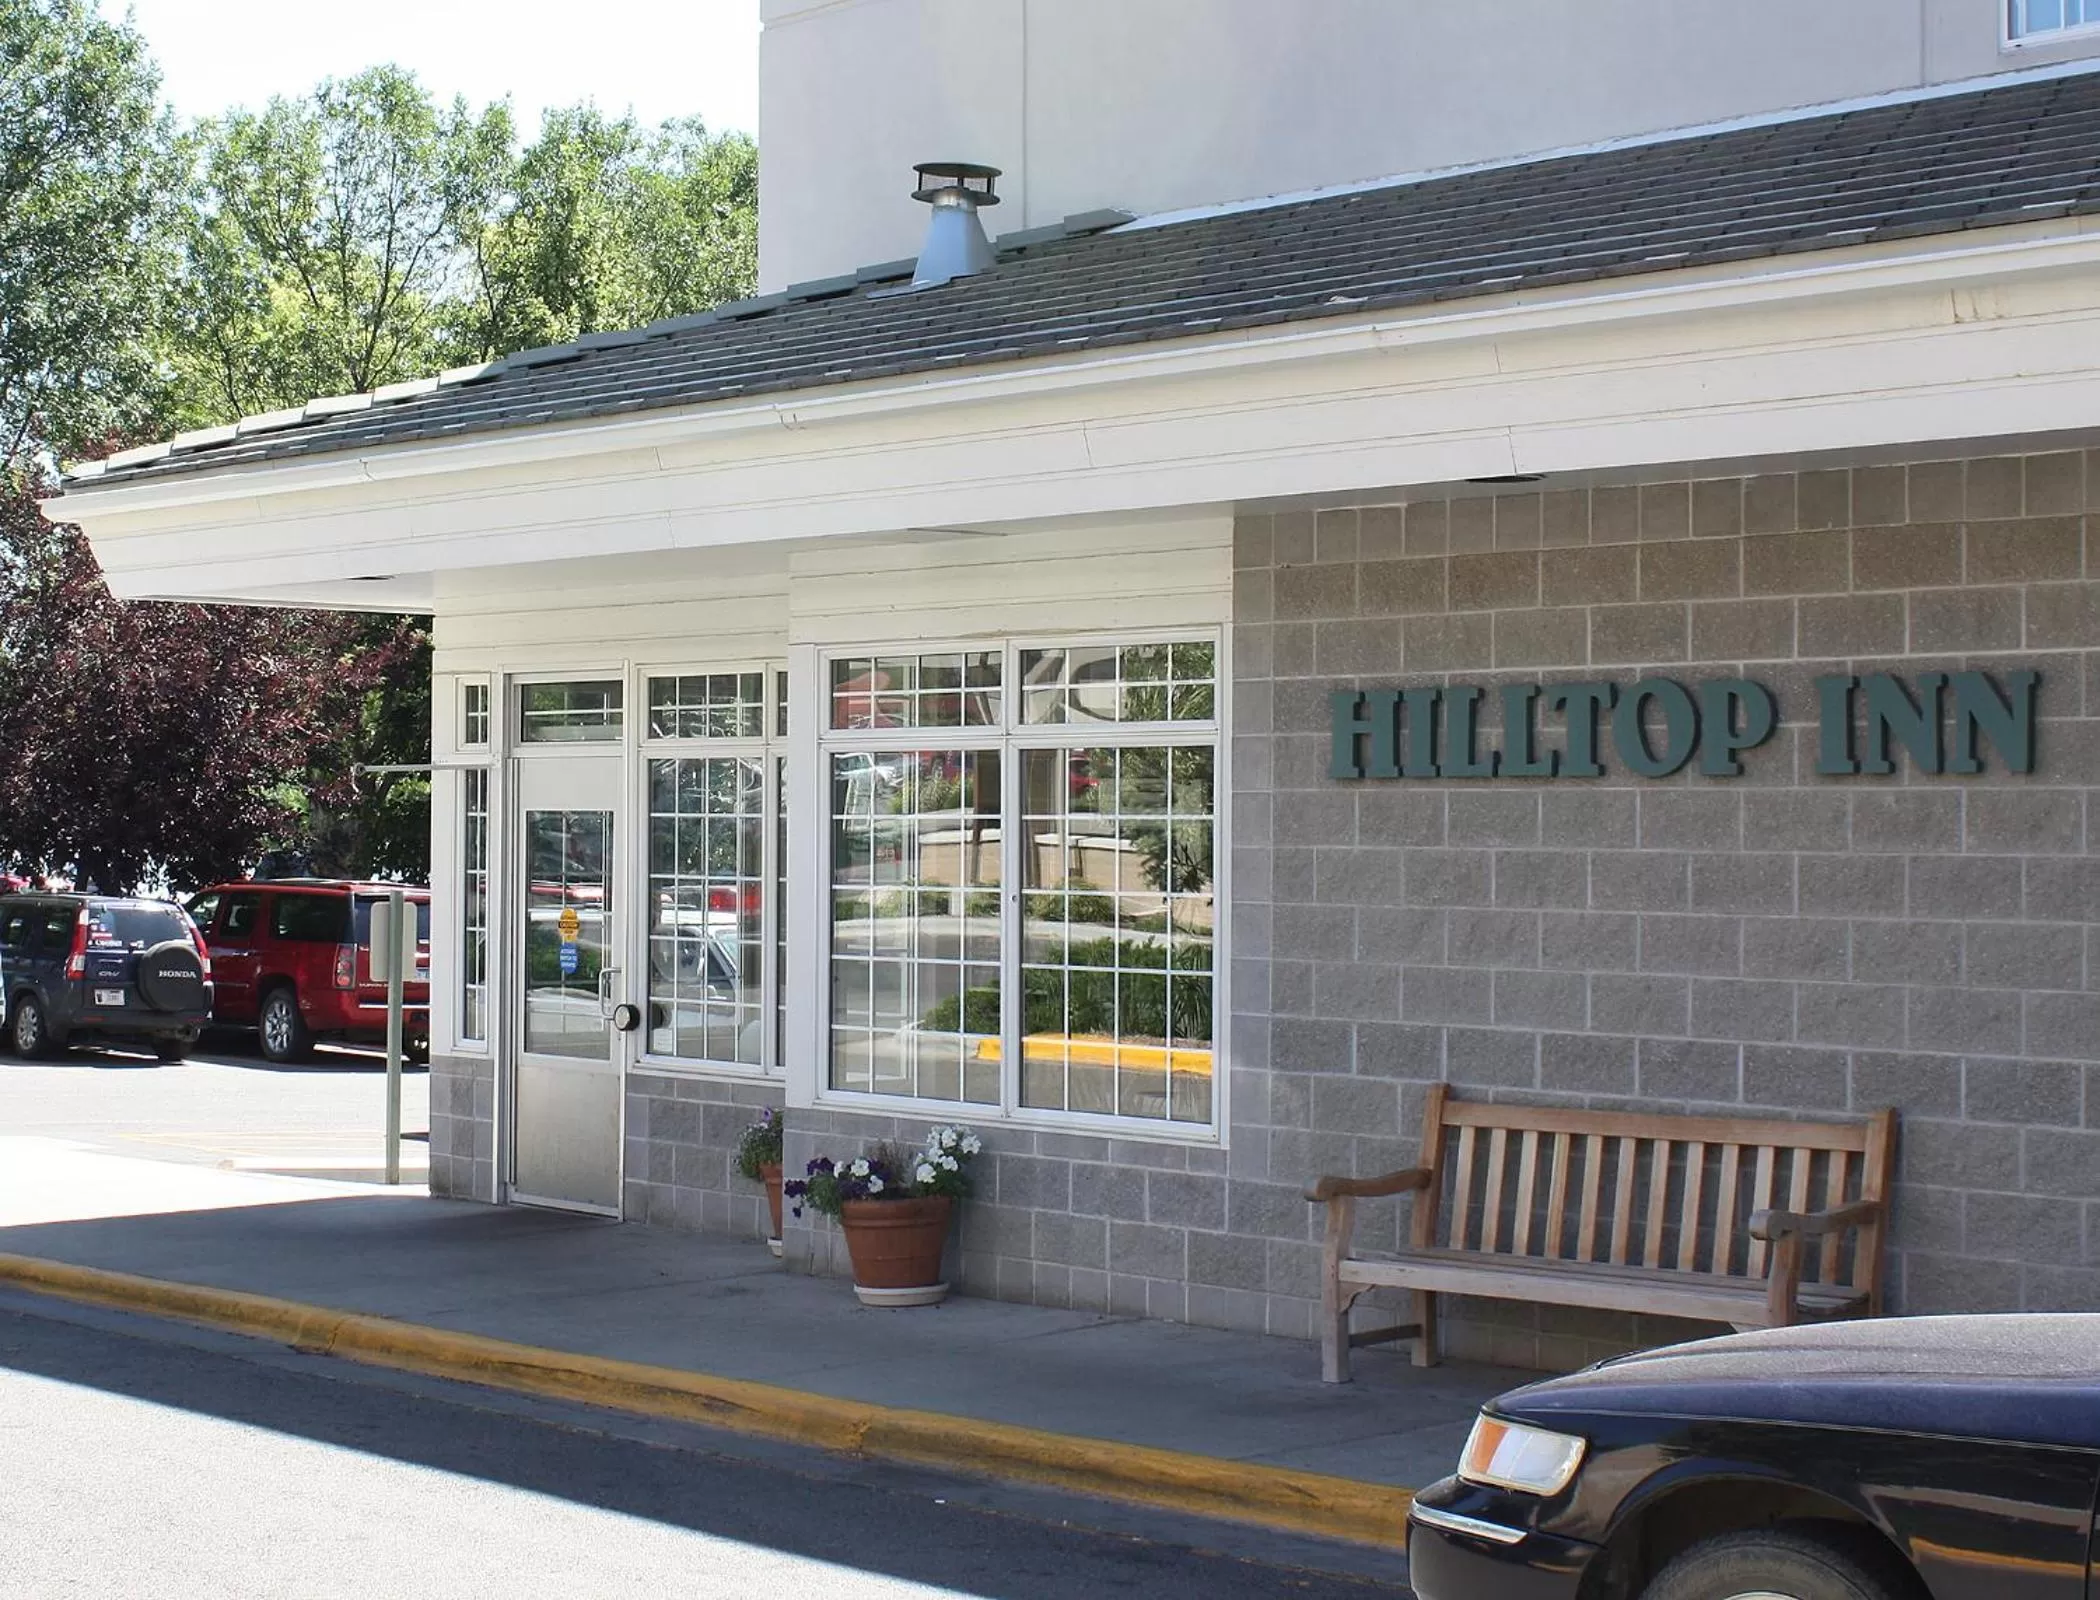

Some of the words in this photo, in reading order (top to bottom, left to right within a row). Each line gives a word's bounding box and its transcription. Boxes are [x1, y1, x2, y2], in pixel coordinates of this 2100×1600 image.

[1328, 676, 1779, 779] HILLTOP
[1815, 670, 2042, 776] INN
[158, 970, 197, 979] HONDA
